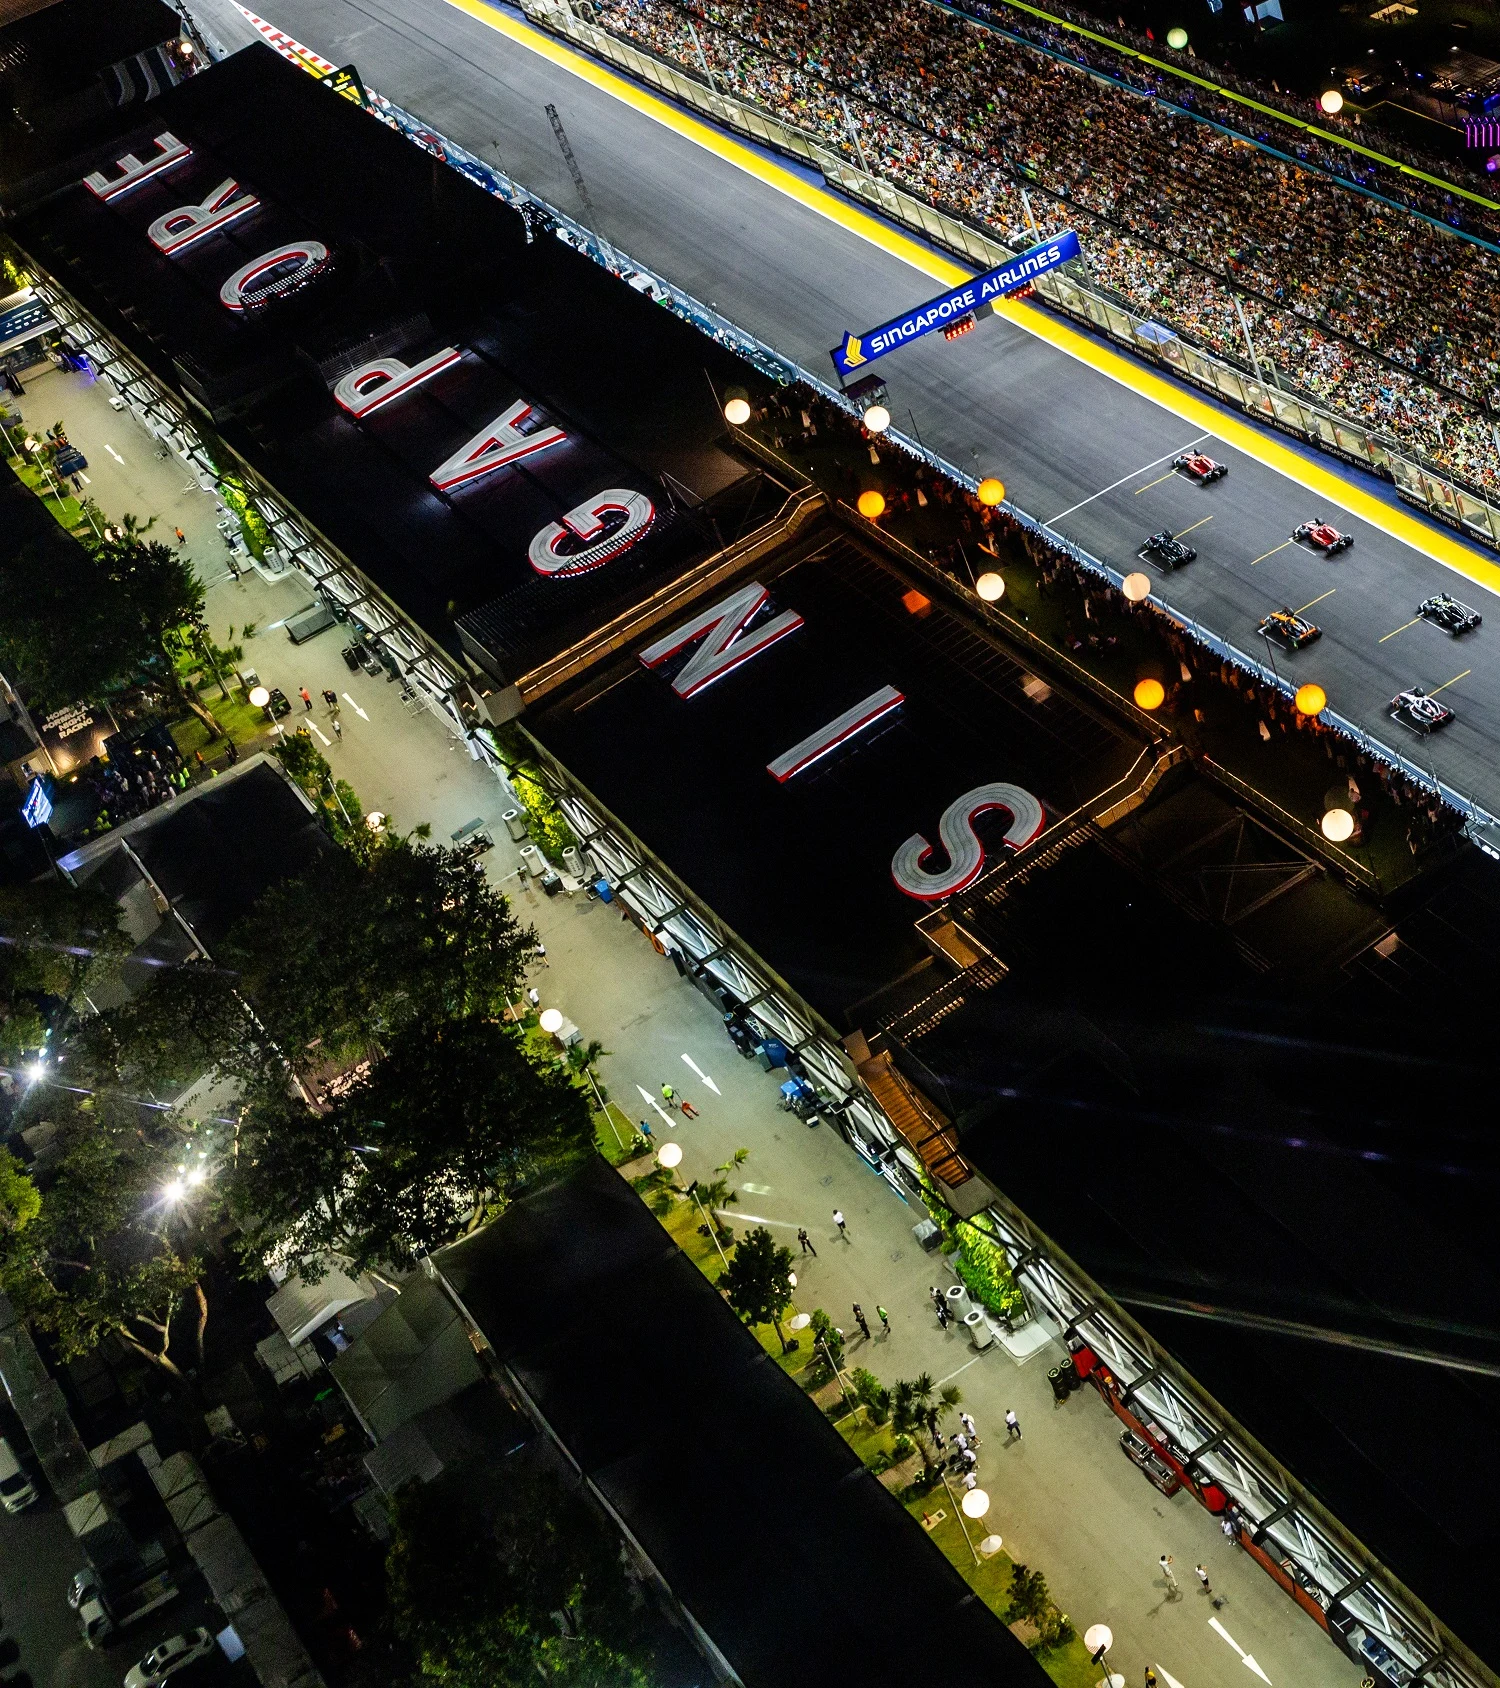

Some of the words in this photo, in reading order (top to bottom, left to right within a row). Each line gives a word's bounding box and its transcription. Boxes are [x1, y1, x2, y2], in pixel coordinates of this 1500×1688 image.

[871, 290, 976, 353] SINGAPORE
[981, 245, 1061, 298] AIRLINES
[42, 705, 89, 732] FORMULA
[58, 716, 94, 740] RACING
[59, 712, 87, 732] NIGHT
